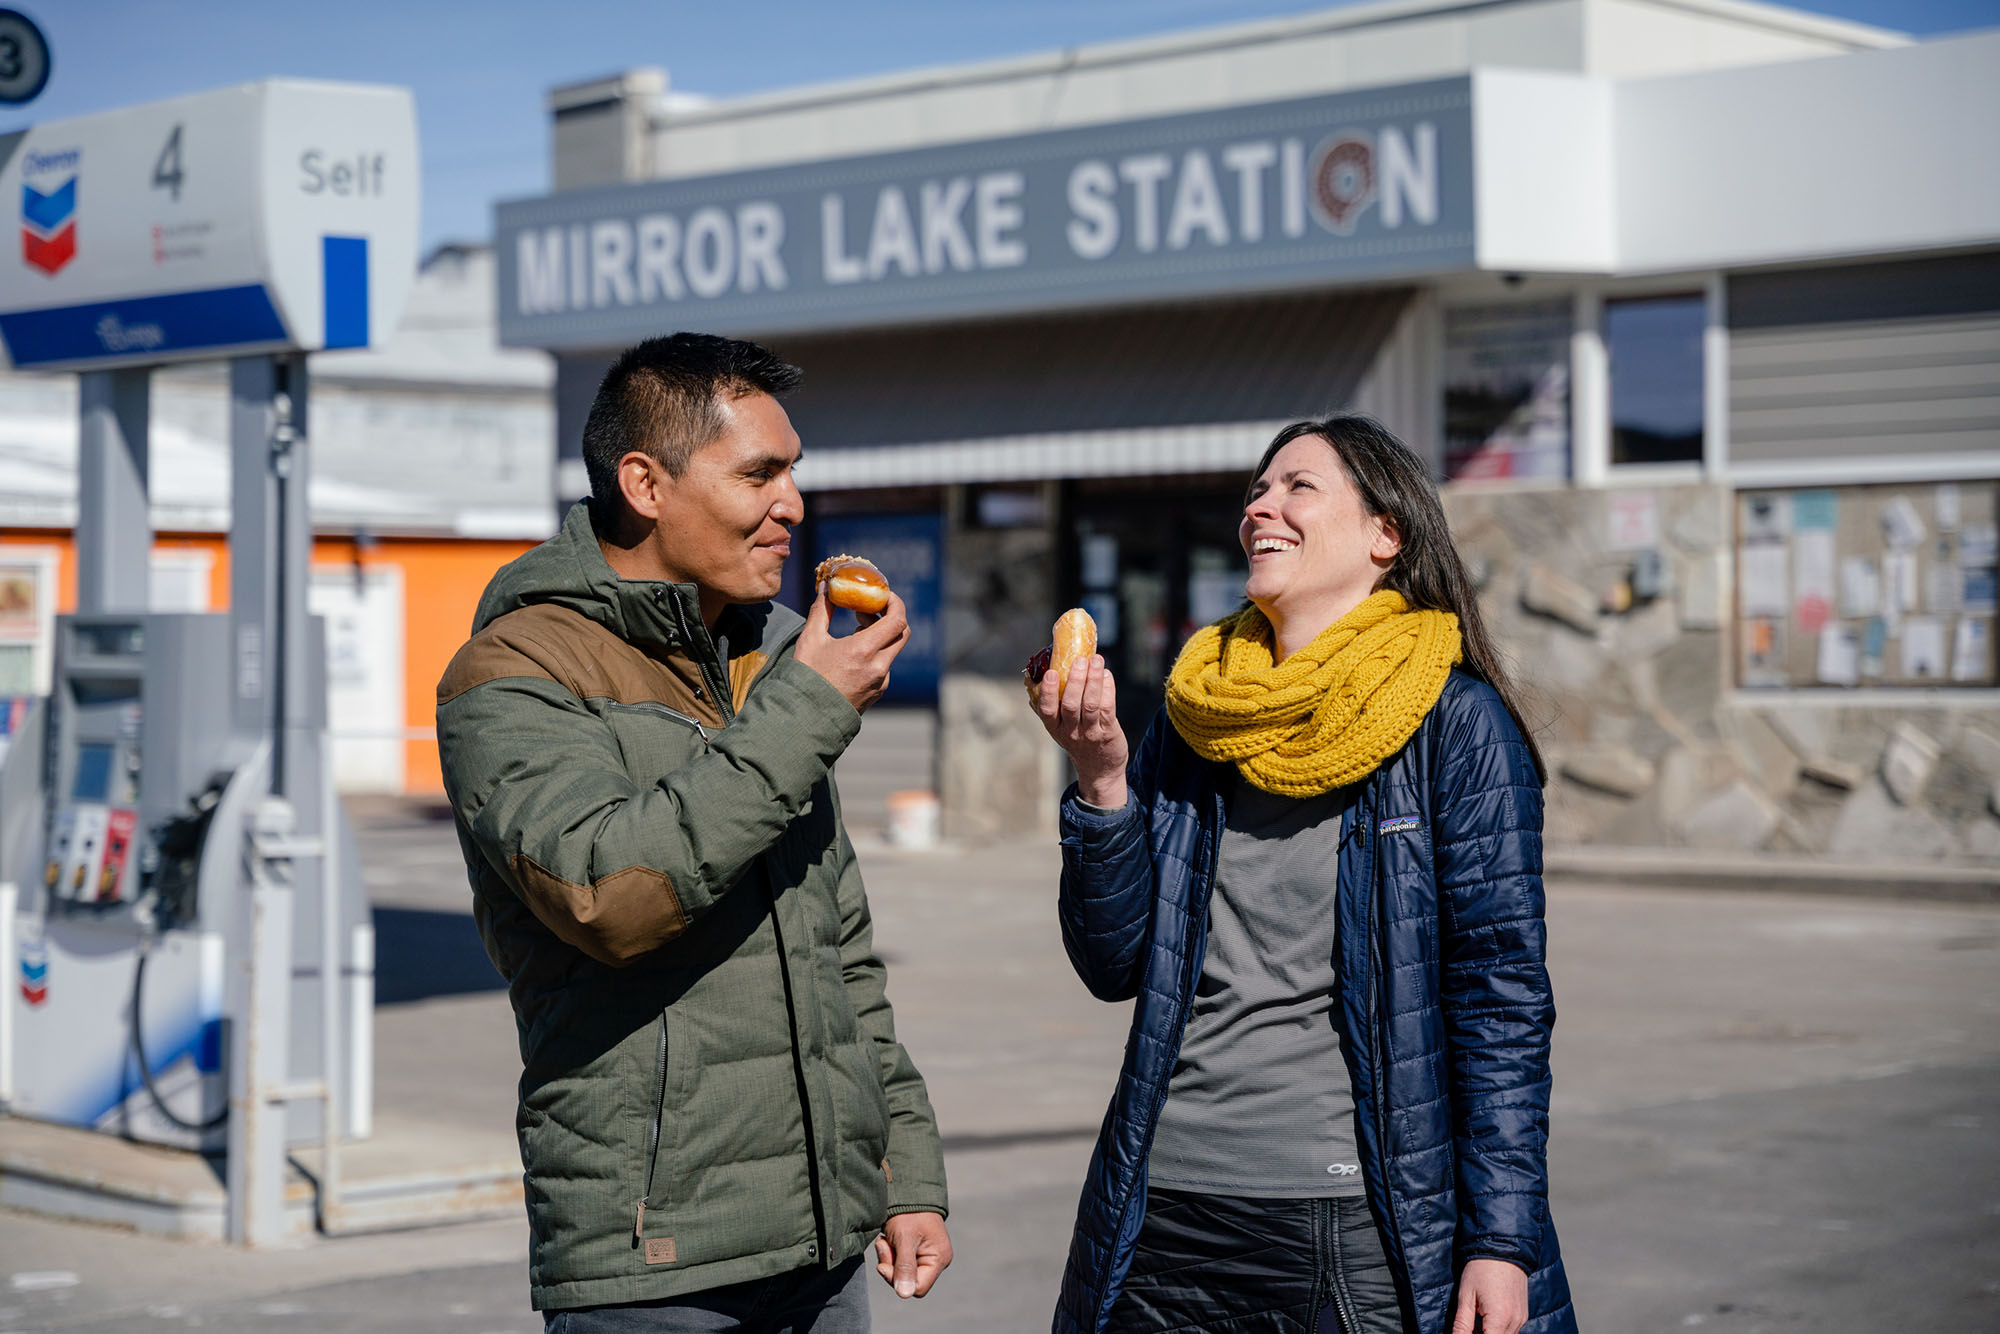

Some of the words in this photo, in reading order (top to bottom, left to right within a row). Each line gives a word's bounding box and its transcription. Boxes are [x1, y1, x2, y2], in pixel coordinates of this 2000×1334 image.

[0, 34, 23, 81] 3
[150, 121, 186, 202] 4
[299, 149, 387, 198] Self
[516, 202, 788, 315] MIRROR
[821, 171, 1028, 285] LAKE
[1066, 121, 1438, 260] STATION
[1380, 823, 1416, 835] patagonia
[1326, 1163, 1358, 1176] OR
